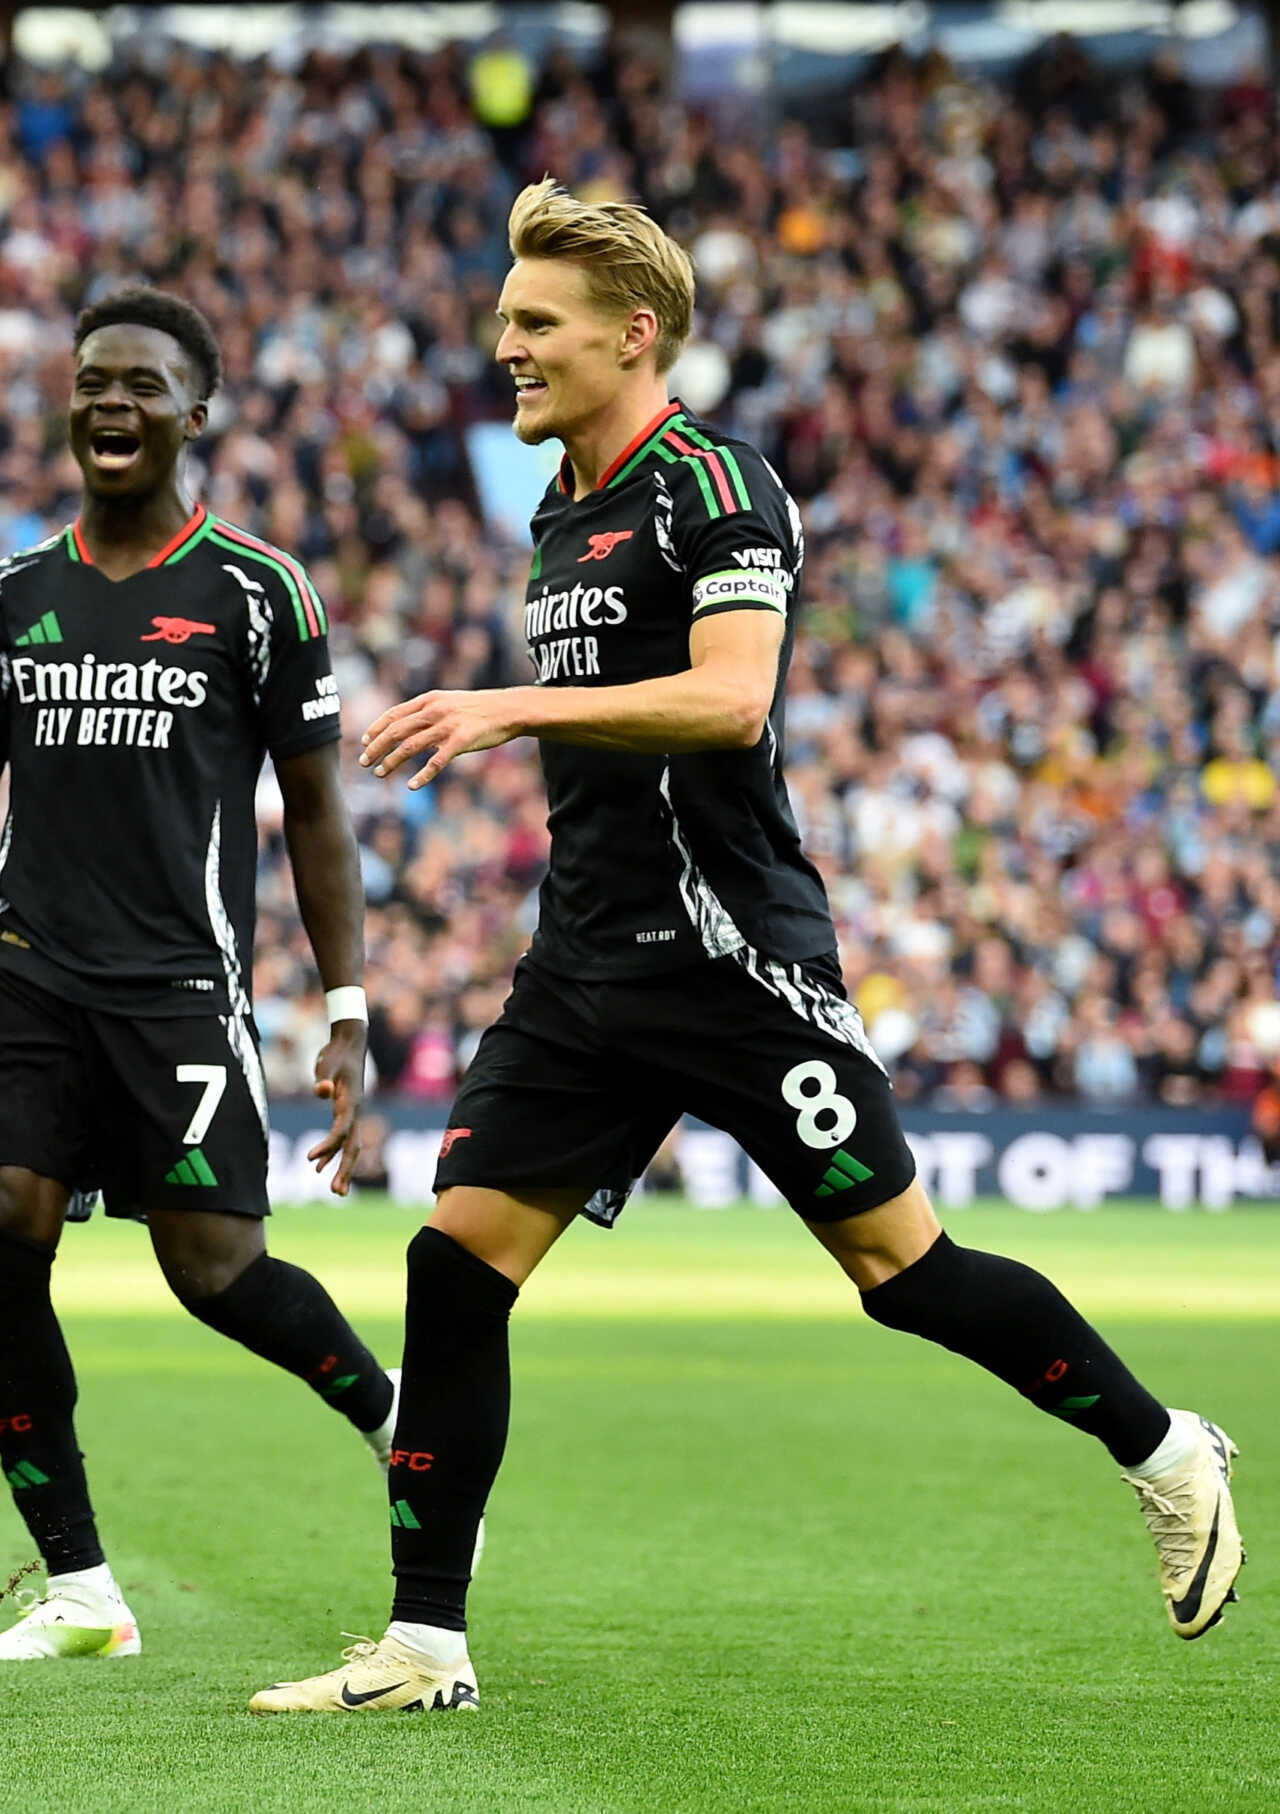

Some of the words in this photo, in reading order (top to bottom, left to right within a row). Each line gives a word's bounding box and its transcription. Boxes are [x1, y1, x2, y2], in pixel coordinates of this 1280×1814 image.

[730, 547, 782, 569] VISIT
[525, 580, 628, 641] mirates
[11, 653, 209, 708] Emirates
[34, 707, 73, 748] FLY
[77, 707, 174, 749] BETTER
[176, 1064, 227, 1144] 7
[781, 1059, 857, 1150] 8
[389, 1448, 436, 1472] FC
